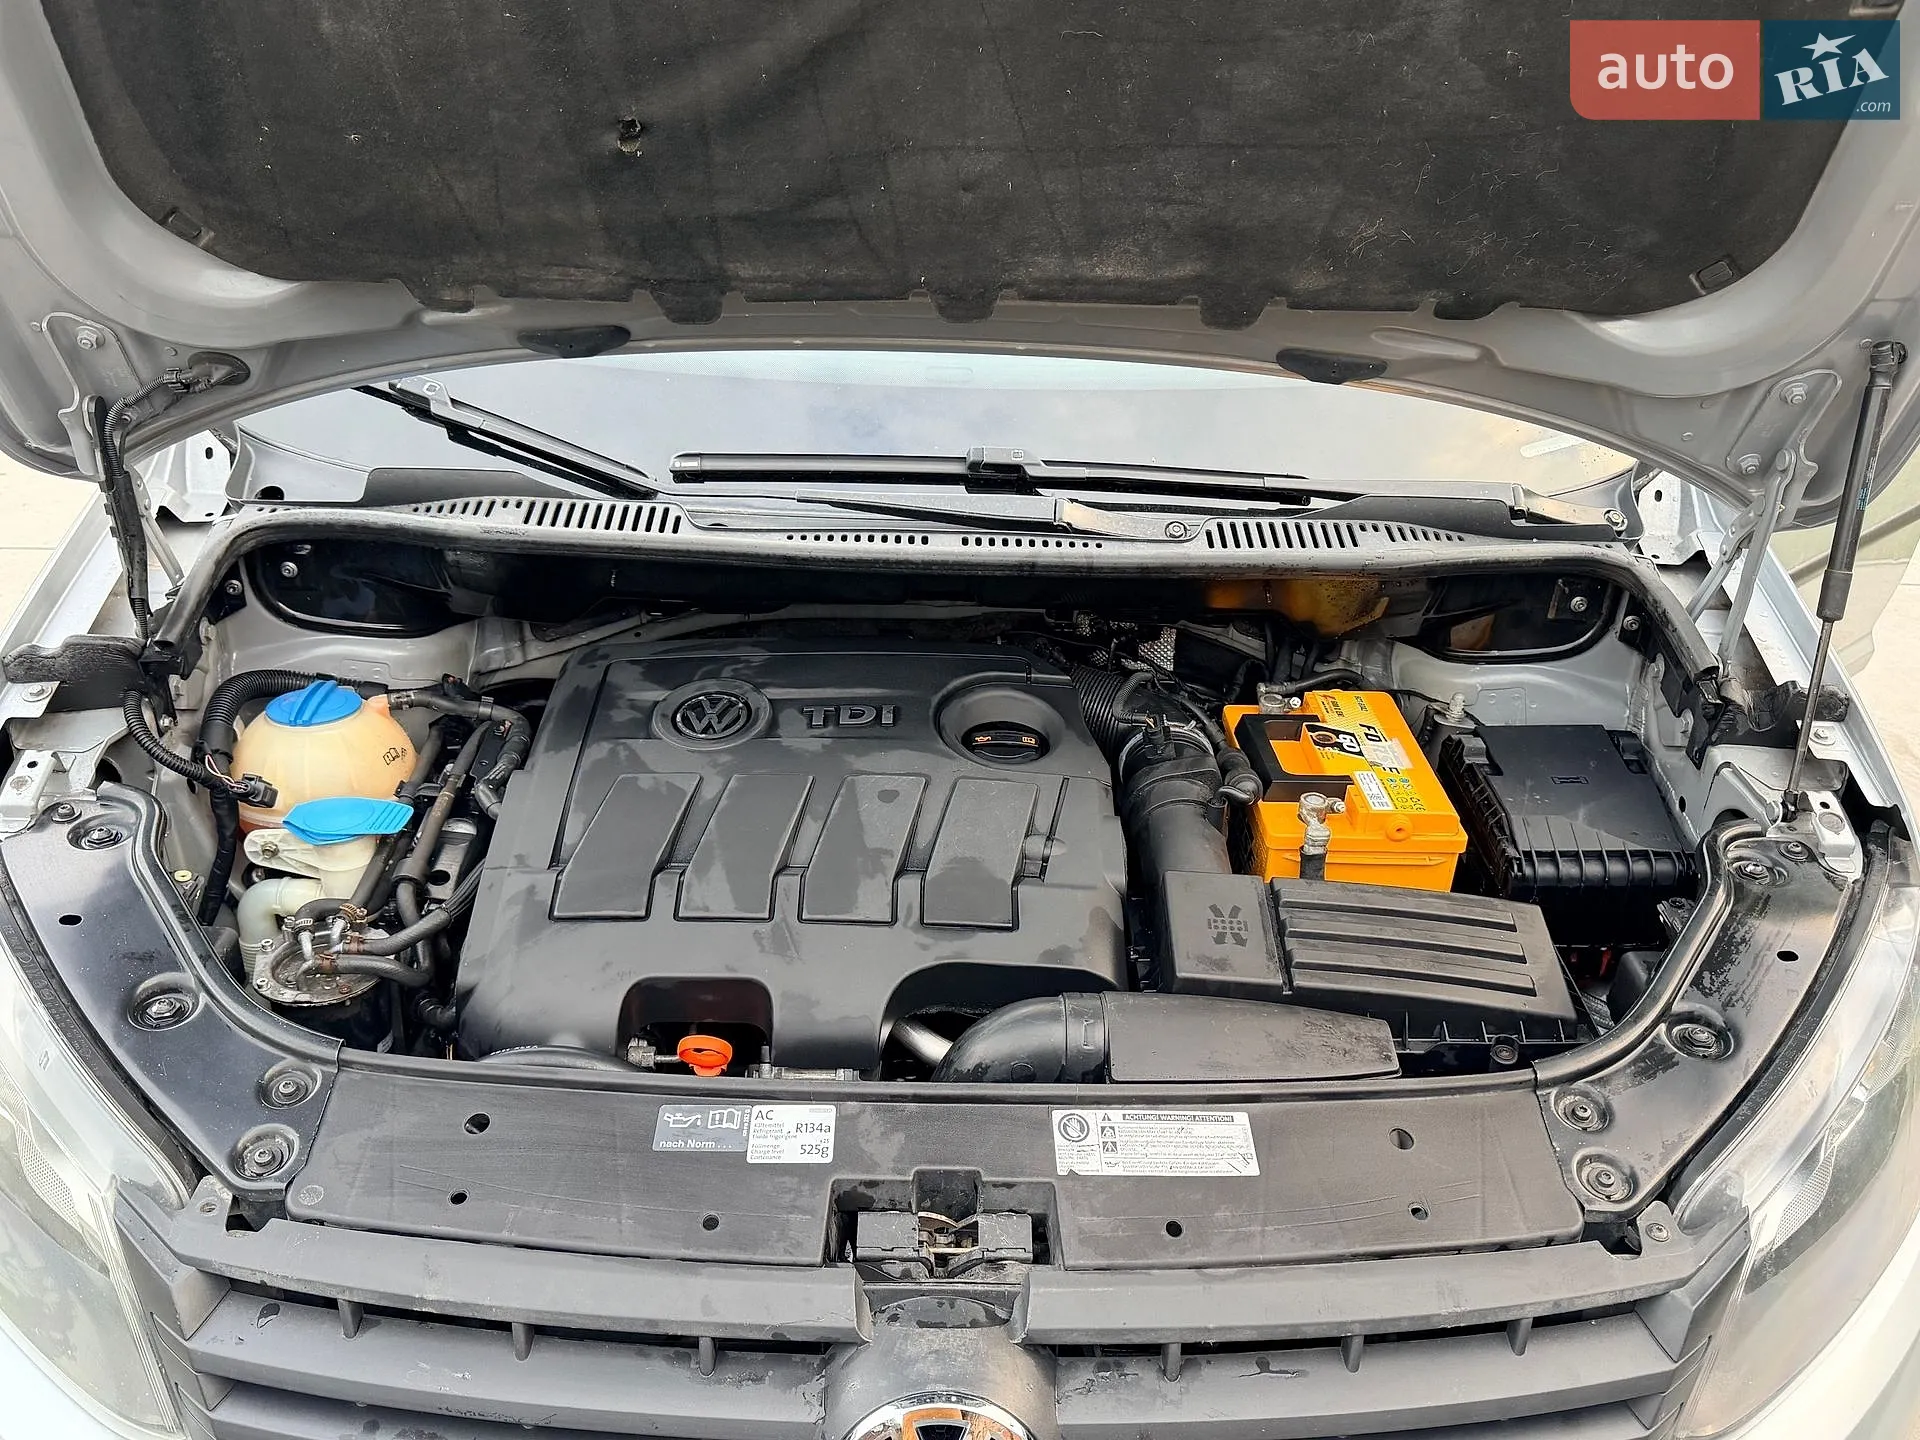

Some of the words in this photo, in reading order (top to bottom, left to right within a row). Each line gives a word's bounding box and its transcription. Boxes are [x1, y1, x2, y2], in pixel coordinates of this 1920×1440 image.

[803, 703, 897, 728] TDI
[755, 1109, 774, 1121] AC
[1125, 1113, 1159, 1121] ACHTUNG!
[1160, 1114, 1194, 1122] WARNING!
[795, 1122, 831, 1134] R134a
[659, 1139, 684, 1149] nach
[686, 1139, 715, 1149] Norm
[799, 1143, 830, 1158] 525g
